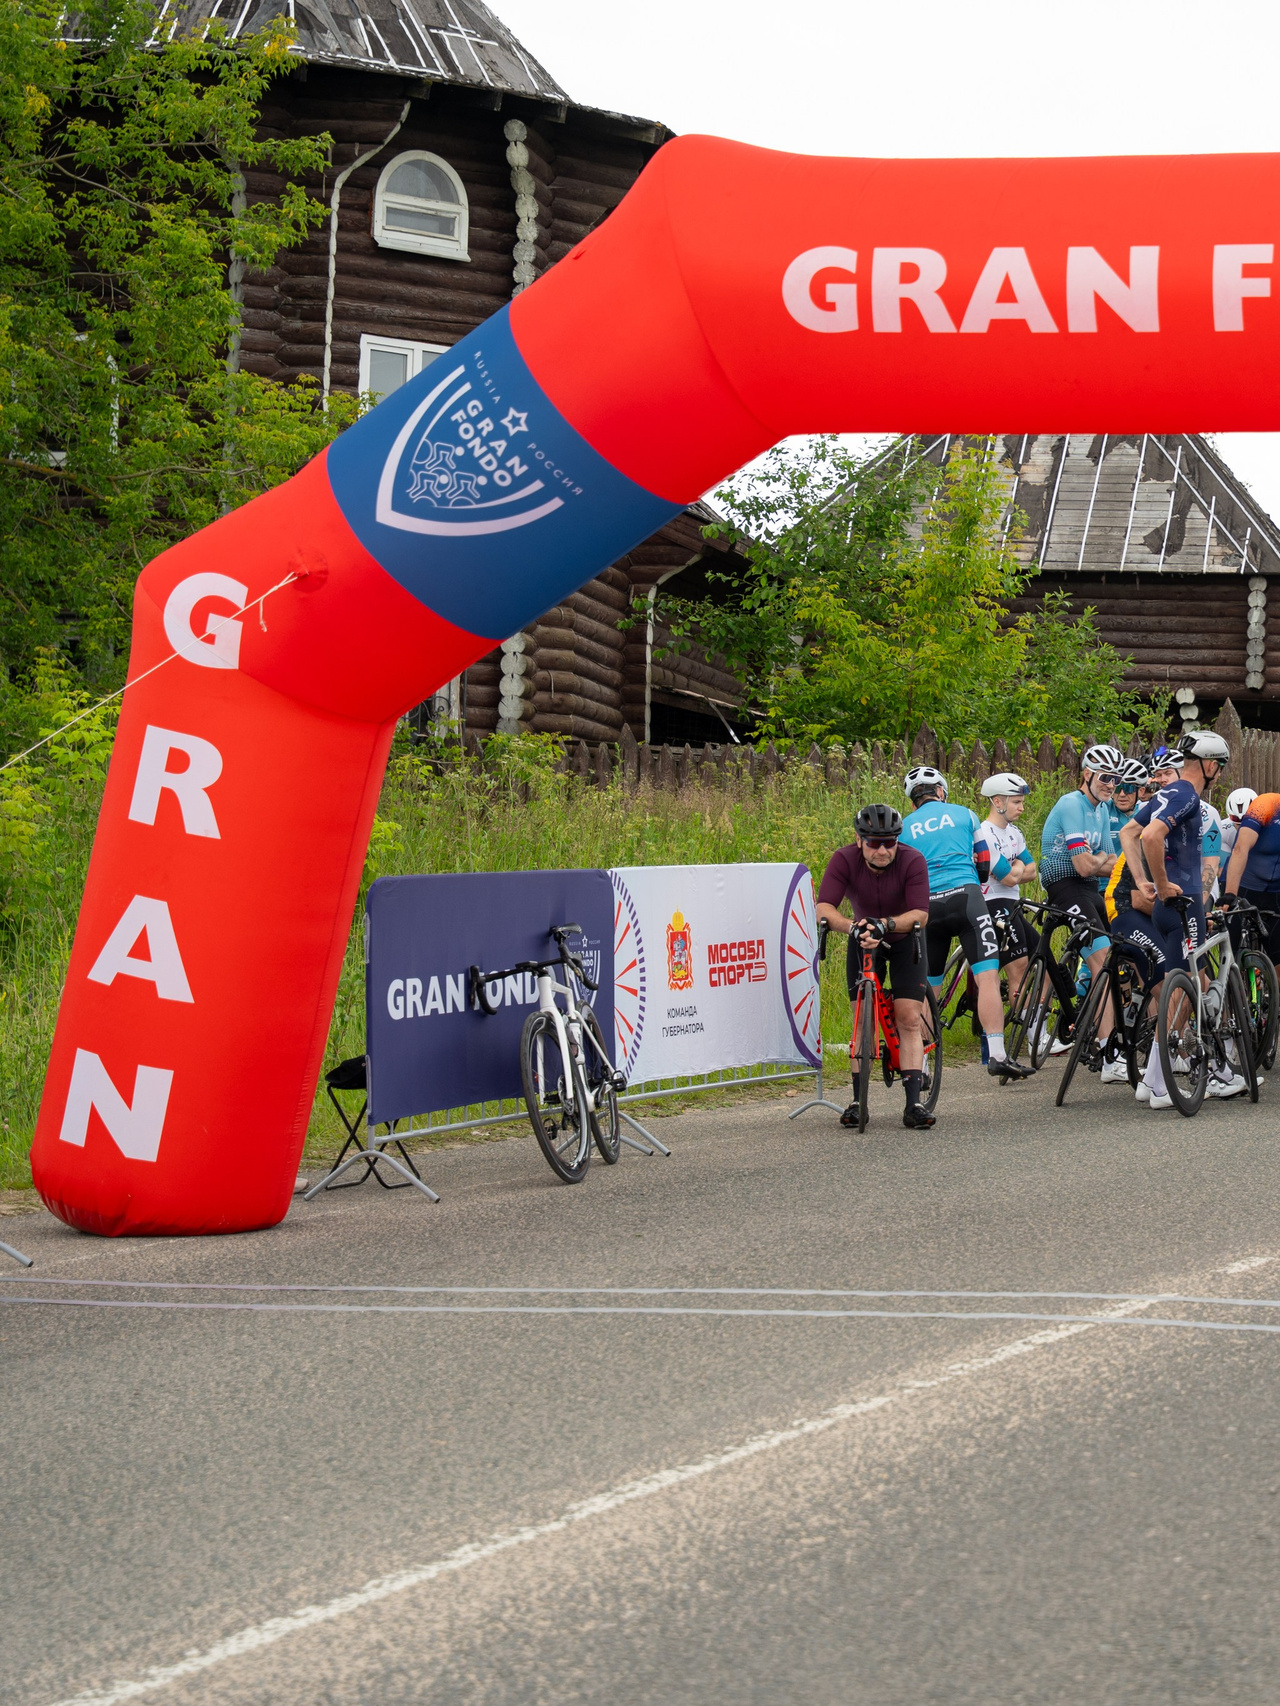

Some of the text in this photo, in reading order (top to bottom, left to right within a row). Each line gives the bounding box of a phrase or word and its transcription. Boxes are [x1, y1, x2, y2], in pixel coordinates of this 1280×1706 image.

[781, 245, 1160, 334] GRAN
[473, 350, 501, 404] RUSSIA
[450, 409, 513, 487] FONDO
[466, 398, 529, 477] GRAN
[527, 442, 583, 497] РОССИЯ
[910, 814, 955, 840] RCA
[1052, 833, 1065, 853] RCA
[59, 572, 249, 1163] GRAN
[707, 939, 765, 965] МОСОБЛ
[976, 913, 999, 957] RCA
[387, 965, 557, 1020] GRAN OND
[709, 962, 754, 987] СПОРТ
[662, 1022, 704, 1038] ГУБЕРНАТОРА
[667, 1005, 697, 1018] КОМАНДА
